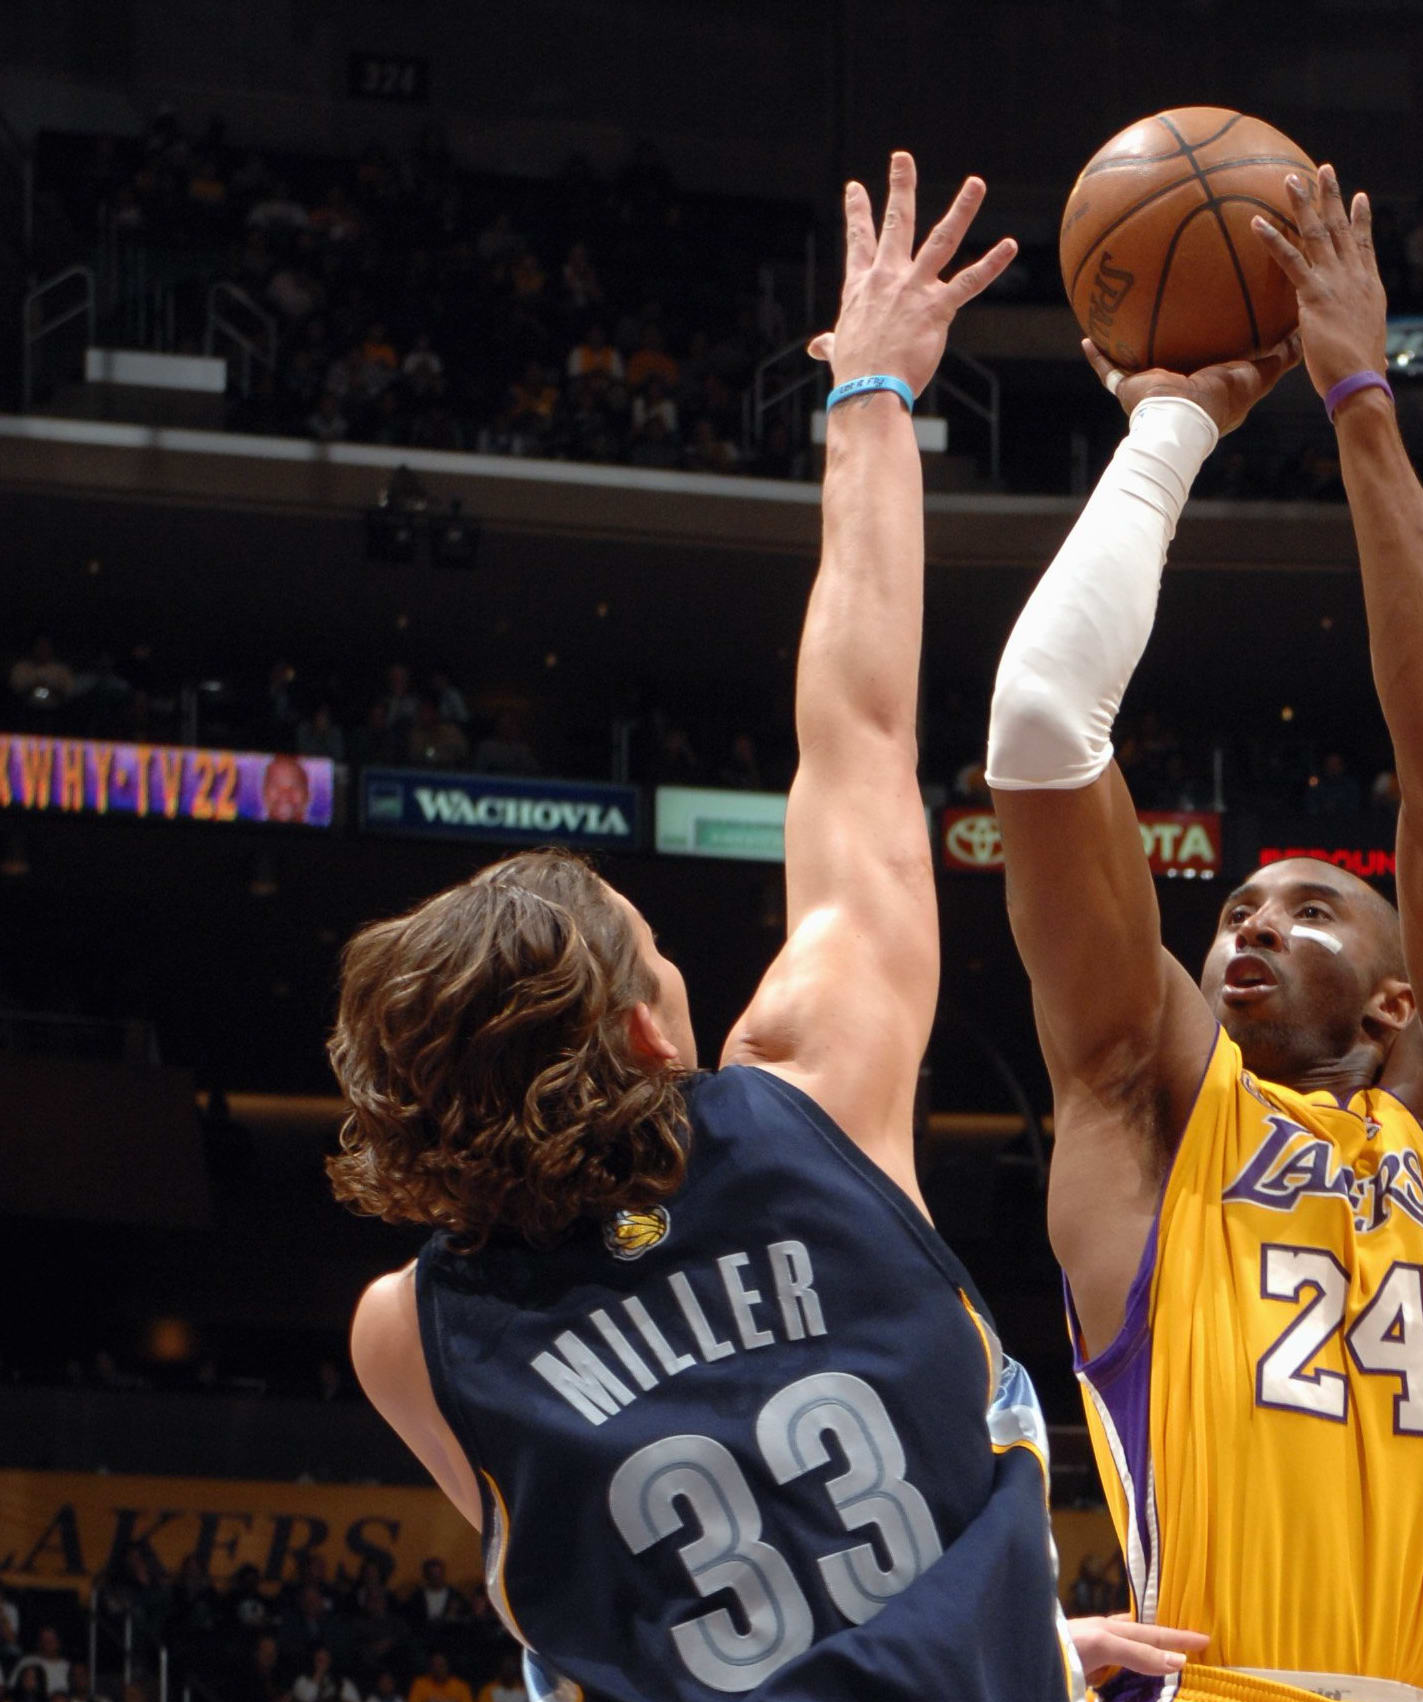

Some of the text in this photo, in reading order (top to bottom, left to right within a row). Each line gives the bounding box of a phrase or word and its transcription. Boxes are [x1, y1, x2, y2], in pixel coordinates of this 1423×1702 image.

[191, 750, 238, 821] 22
[415, 787, 630, 836] WACHOVIA
[530, 1240, 829, 1427] MILLER
[0, 1501, 403, 1585] AKERS
[608, 1371, 944, 1693] 33
